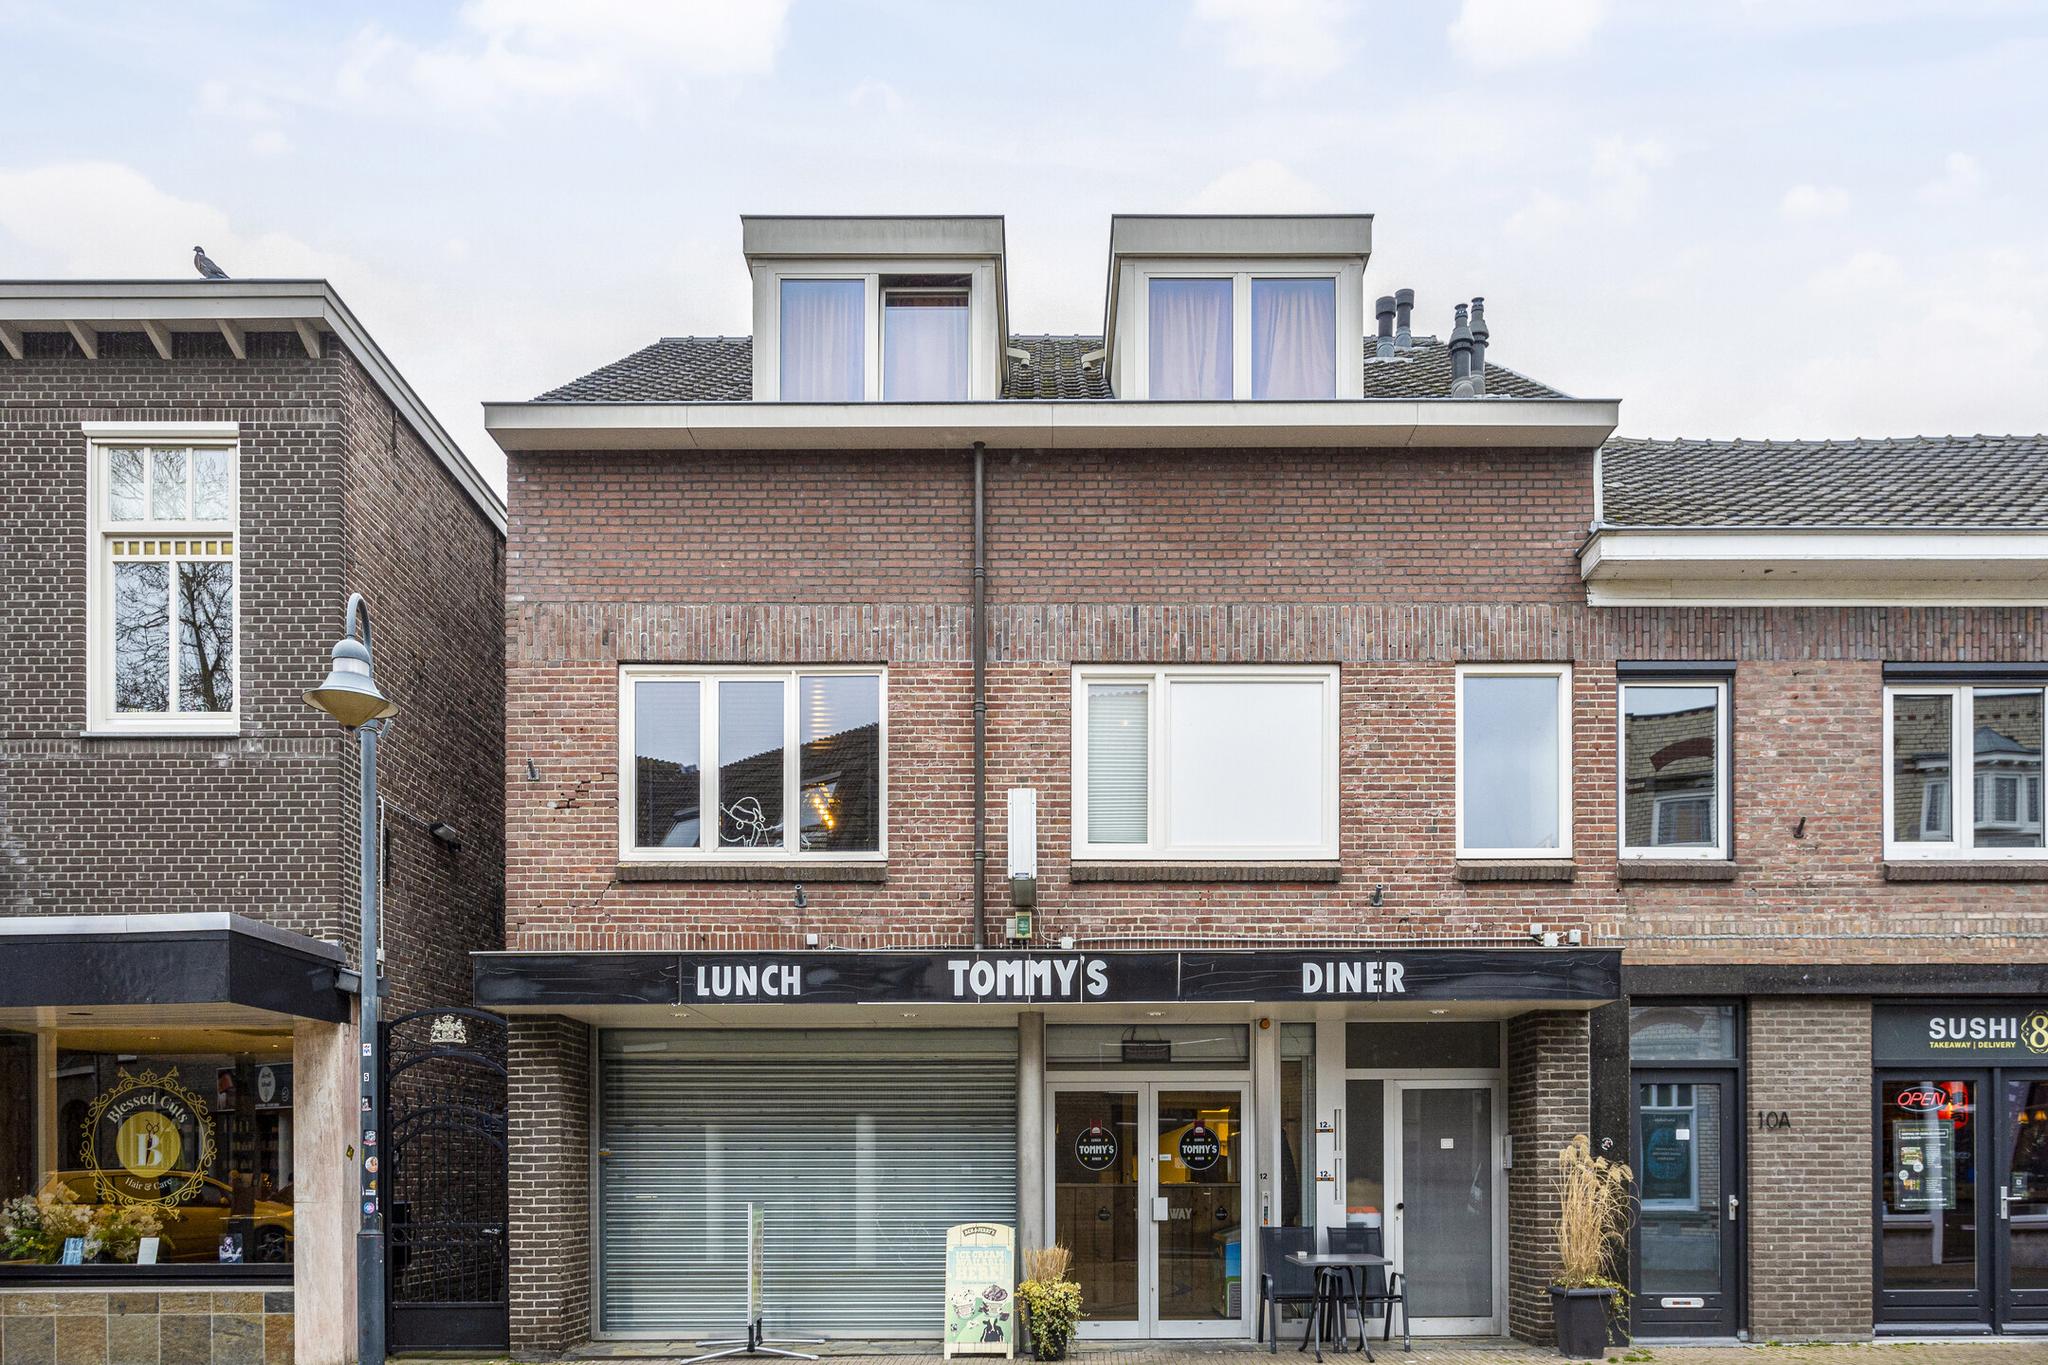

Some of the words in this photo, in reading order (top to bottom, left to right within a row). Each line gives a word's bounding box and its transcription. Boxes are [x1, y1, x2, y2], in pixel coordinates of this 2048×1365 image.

[697, 965, 801, 997] LUNCH
[948, 955, 1109, 997] TOMMY'S
[1302, 961, 1406, 994] DINER
[1929, 1017, 2017, 1040] SUSHI
[2029, 1015, 2048, 1048] 8
[1929, 1041, 1971, 1049] TAKEAWAY
[1978, 1041, 2016, 1049] DELIVERY
[1897, 1091, 1946, 1106] OPEN
[107, 1092, 157, 1124] Blessed
[160, 1095, 188, 1123] Cuts
[1758, 1111, 1791, 1129] 10A
[1079, 1144, 1114, 1154] TOMMY'S
[1182, 1144, 1217, 1154] TOMMY'S
[125, 1177, 142, 1190] Hair
[153, 1178, 173, 1190] Care
